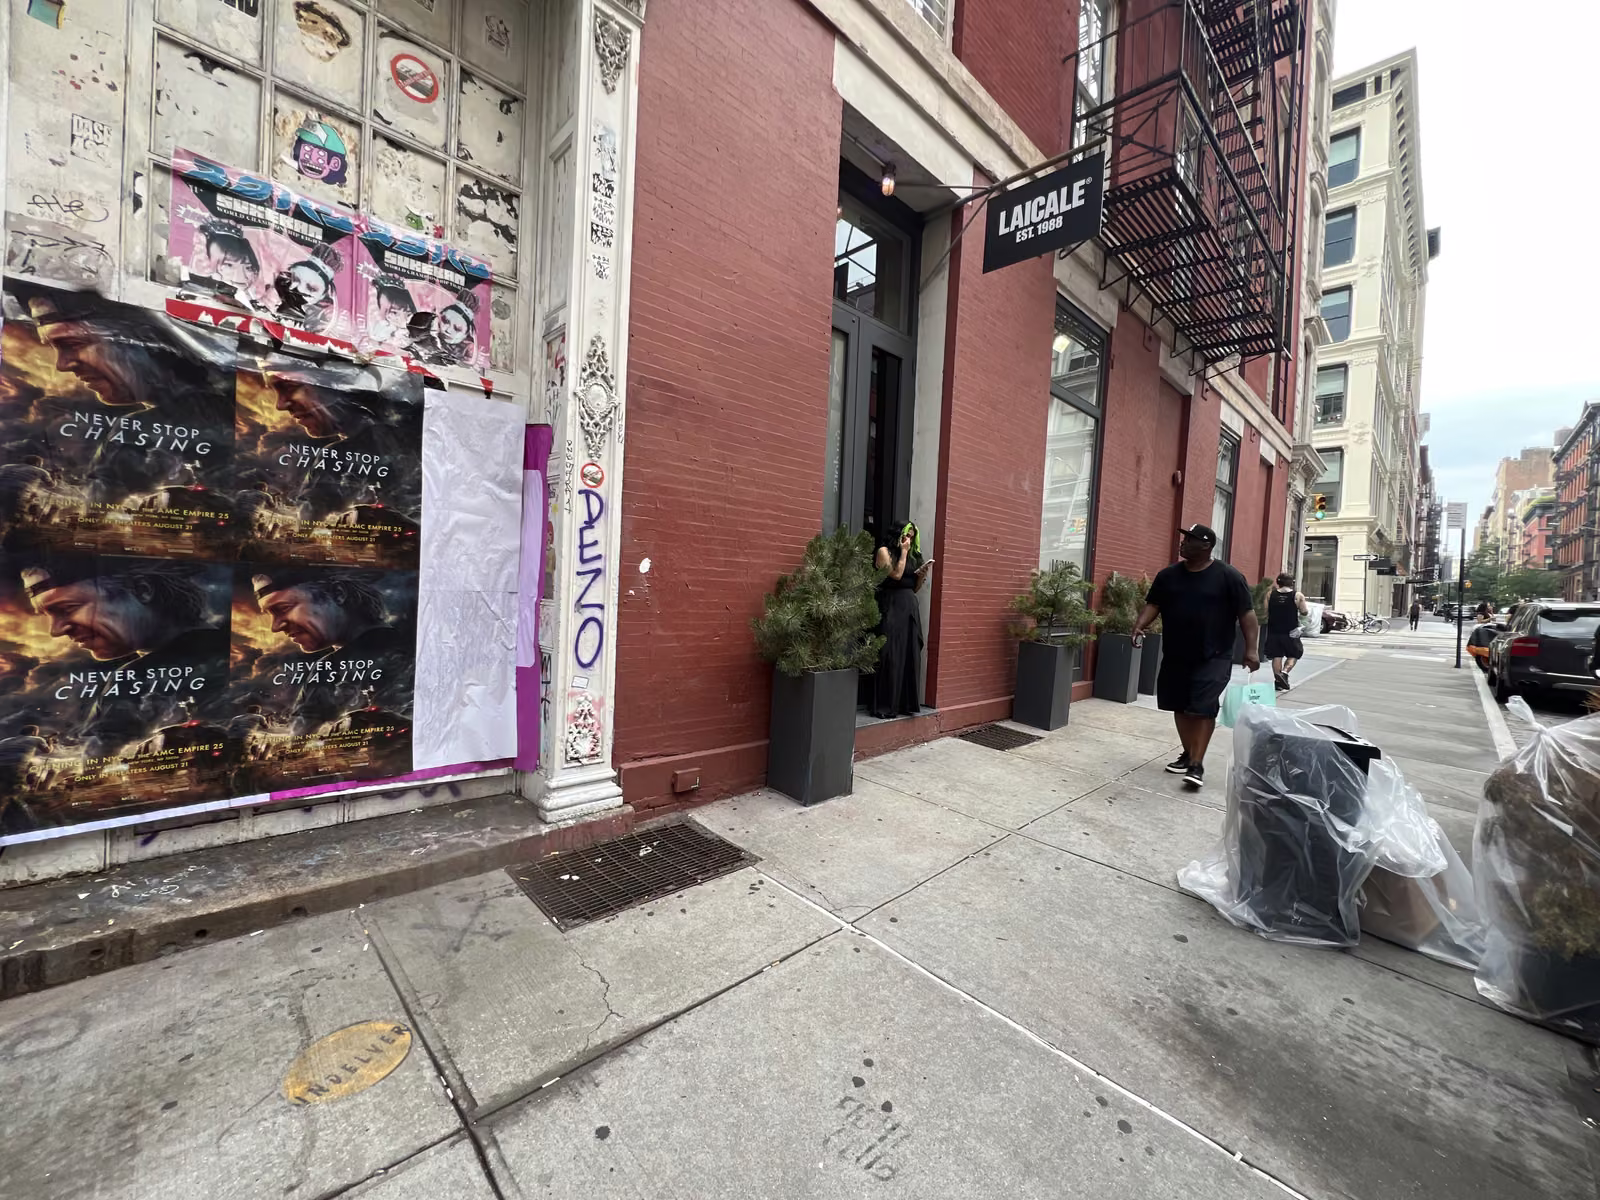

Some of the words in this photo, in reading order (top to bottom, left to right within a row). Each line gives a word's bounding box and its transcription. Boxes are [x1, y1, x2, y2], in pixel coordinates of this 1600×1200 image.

[217, 206, 245, 220] WORLD
[1015, 226, 1035, 243] EST.
[1037, 215, 1063, 236] 1988
[75, 411, 142, 431] NEVER
[153, 423, 200, 439] STOP
[59, 423, 212, 455] CHASING
[289, 443, 338, 459] NEVER
[345, 451, 381, 464] STOP
[279, 454, 389, 477] CHASING
[157, 507, 180, 515] AMC
[183, 509, 215, 518] EMPIRE
[218, 512, 229, 520] 25
[367, 524, 392, 532] EMPIRE
[70, 670, 136, 684] NEVER
[146, 667, 193, 679] STOP
[283, 661, 333, 672] NEVER
[339, 660, 374, 670] STOP
[272, 669, 383, 686] CHASING
[55, 677, 205, 700] CHASING
[360, 726, 385, 734] EMPIRE
[103, 756, 124, 764] NYC
[153, 749, 175, 757] AMC
[178, 744, 210, 754] EMPIRE
[74, 774, 97, 782] ONLY
[149, 763, 179, 772] AUGUST
